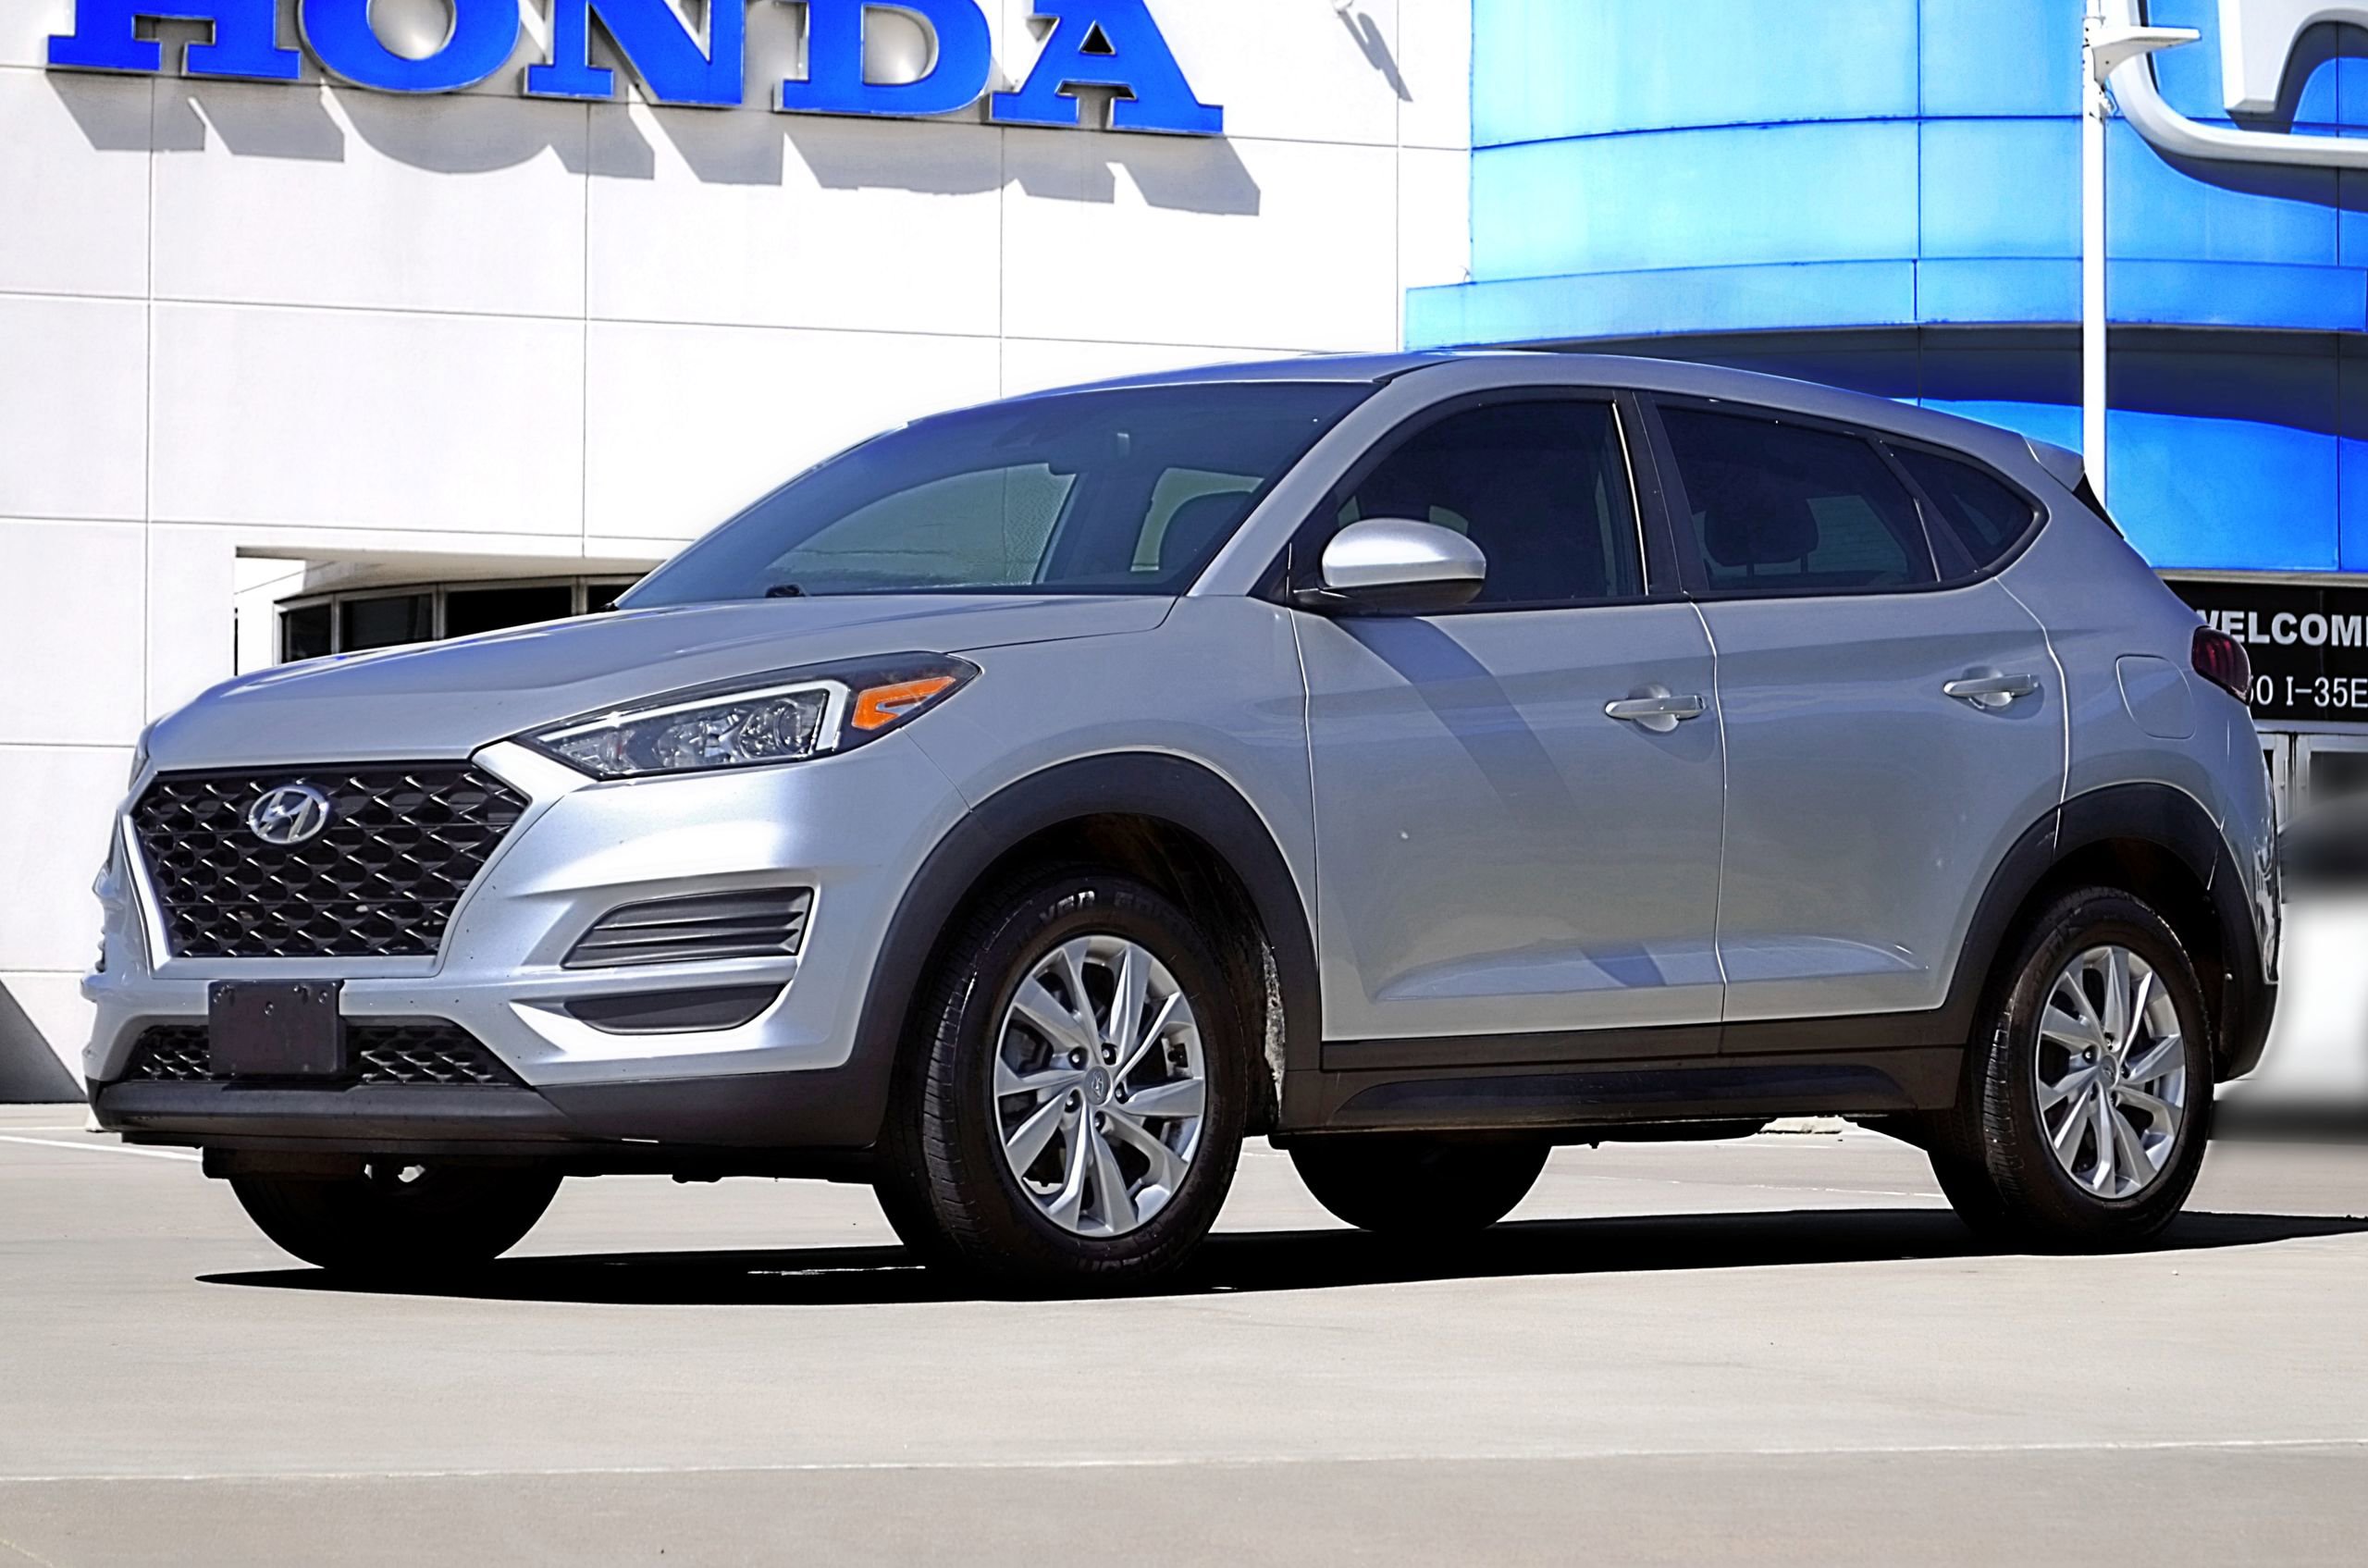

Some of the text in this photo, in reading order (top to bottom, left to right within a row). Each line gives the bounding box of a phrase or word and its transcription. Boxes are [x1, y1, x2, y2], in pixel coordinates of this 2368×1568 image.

[47, 0, 1224, 135] HONDA
[2195, 609, 2368, 648] ELCOM
[2250, 674, 2368, 709] 0 I-35E
